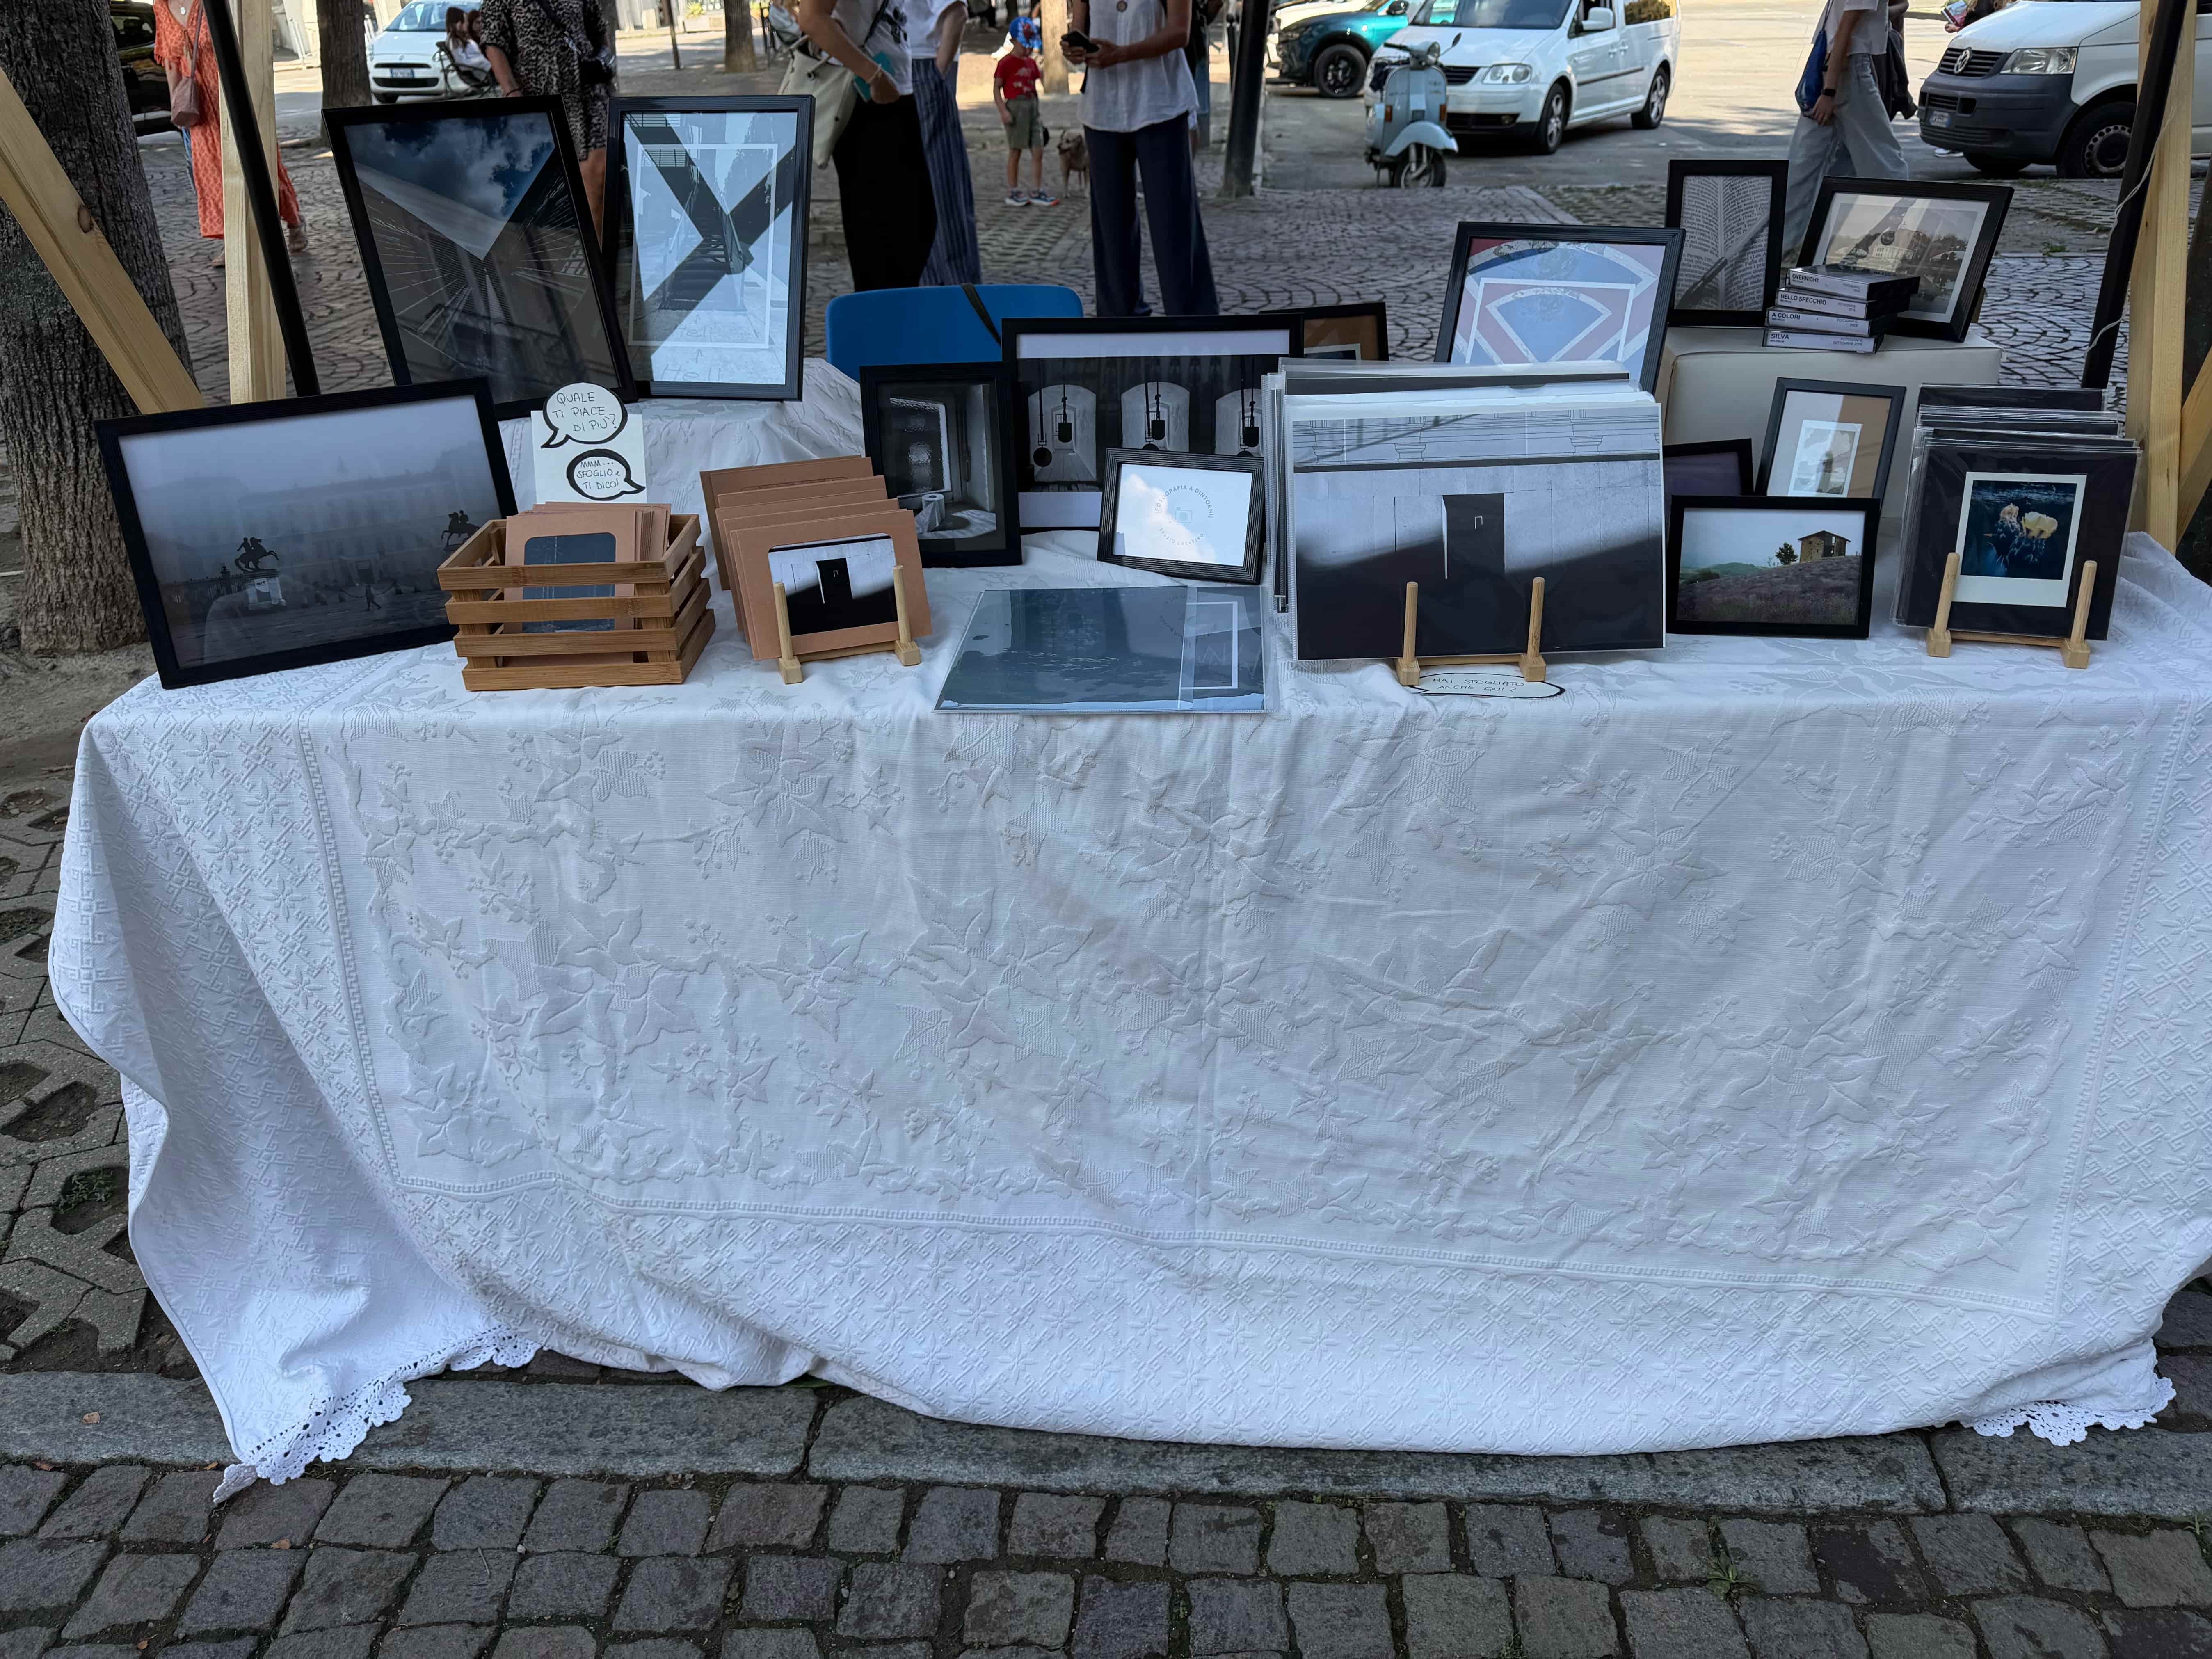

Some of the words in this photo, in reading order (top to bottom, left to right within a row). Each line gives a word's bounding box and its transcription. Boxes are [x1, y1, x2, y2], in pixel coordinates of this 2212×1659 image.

[1792, 274, 1819, 283] OVERNIGHT
[1798, 296, 1826, 305] SPECCHIO
[557, 392, 595, 405] QUALE
[571, 406, 606, 416] PIACE
[573, 424, 585, 432] DI
[576, 469, 613, 478] SFOGLIO
[582, 482, 591, 490] TI
[596, 478, 621, 491] DICO!
